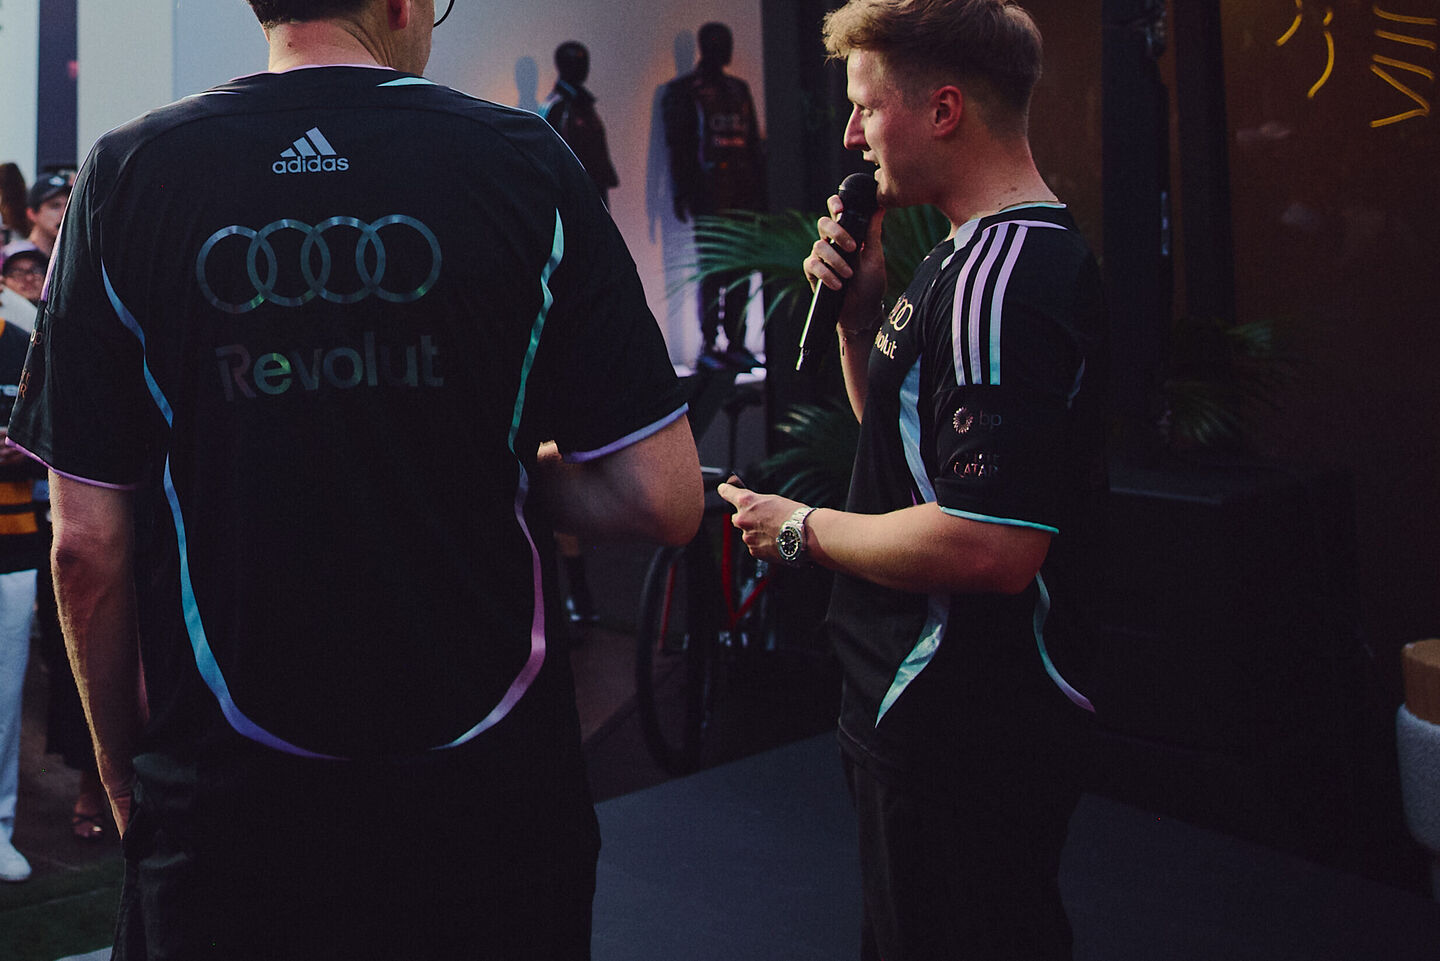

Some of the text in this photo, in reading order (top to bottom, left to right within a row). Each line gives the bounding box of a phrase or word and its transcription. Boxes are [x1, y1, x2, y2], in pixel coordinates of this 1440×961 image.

[272, 155, 350, 174] adidas
[875, 328, 897, 359] olut
[215, 331, 444, 401] Revolut
